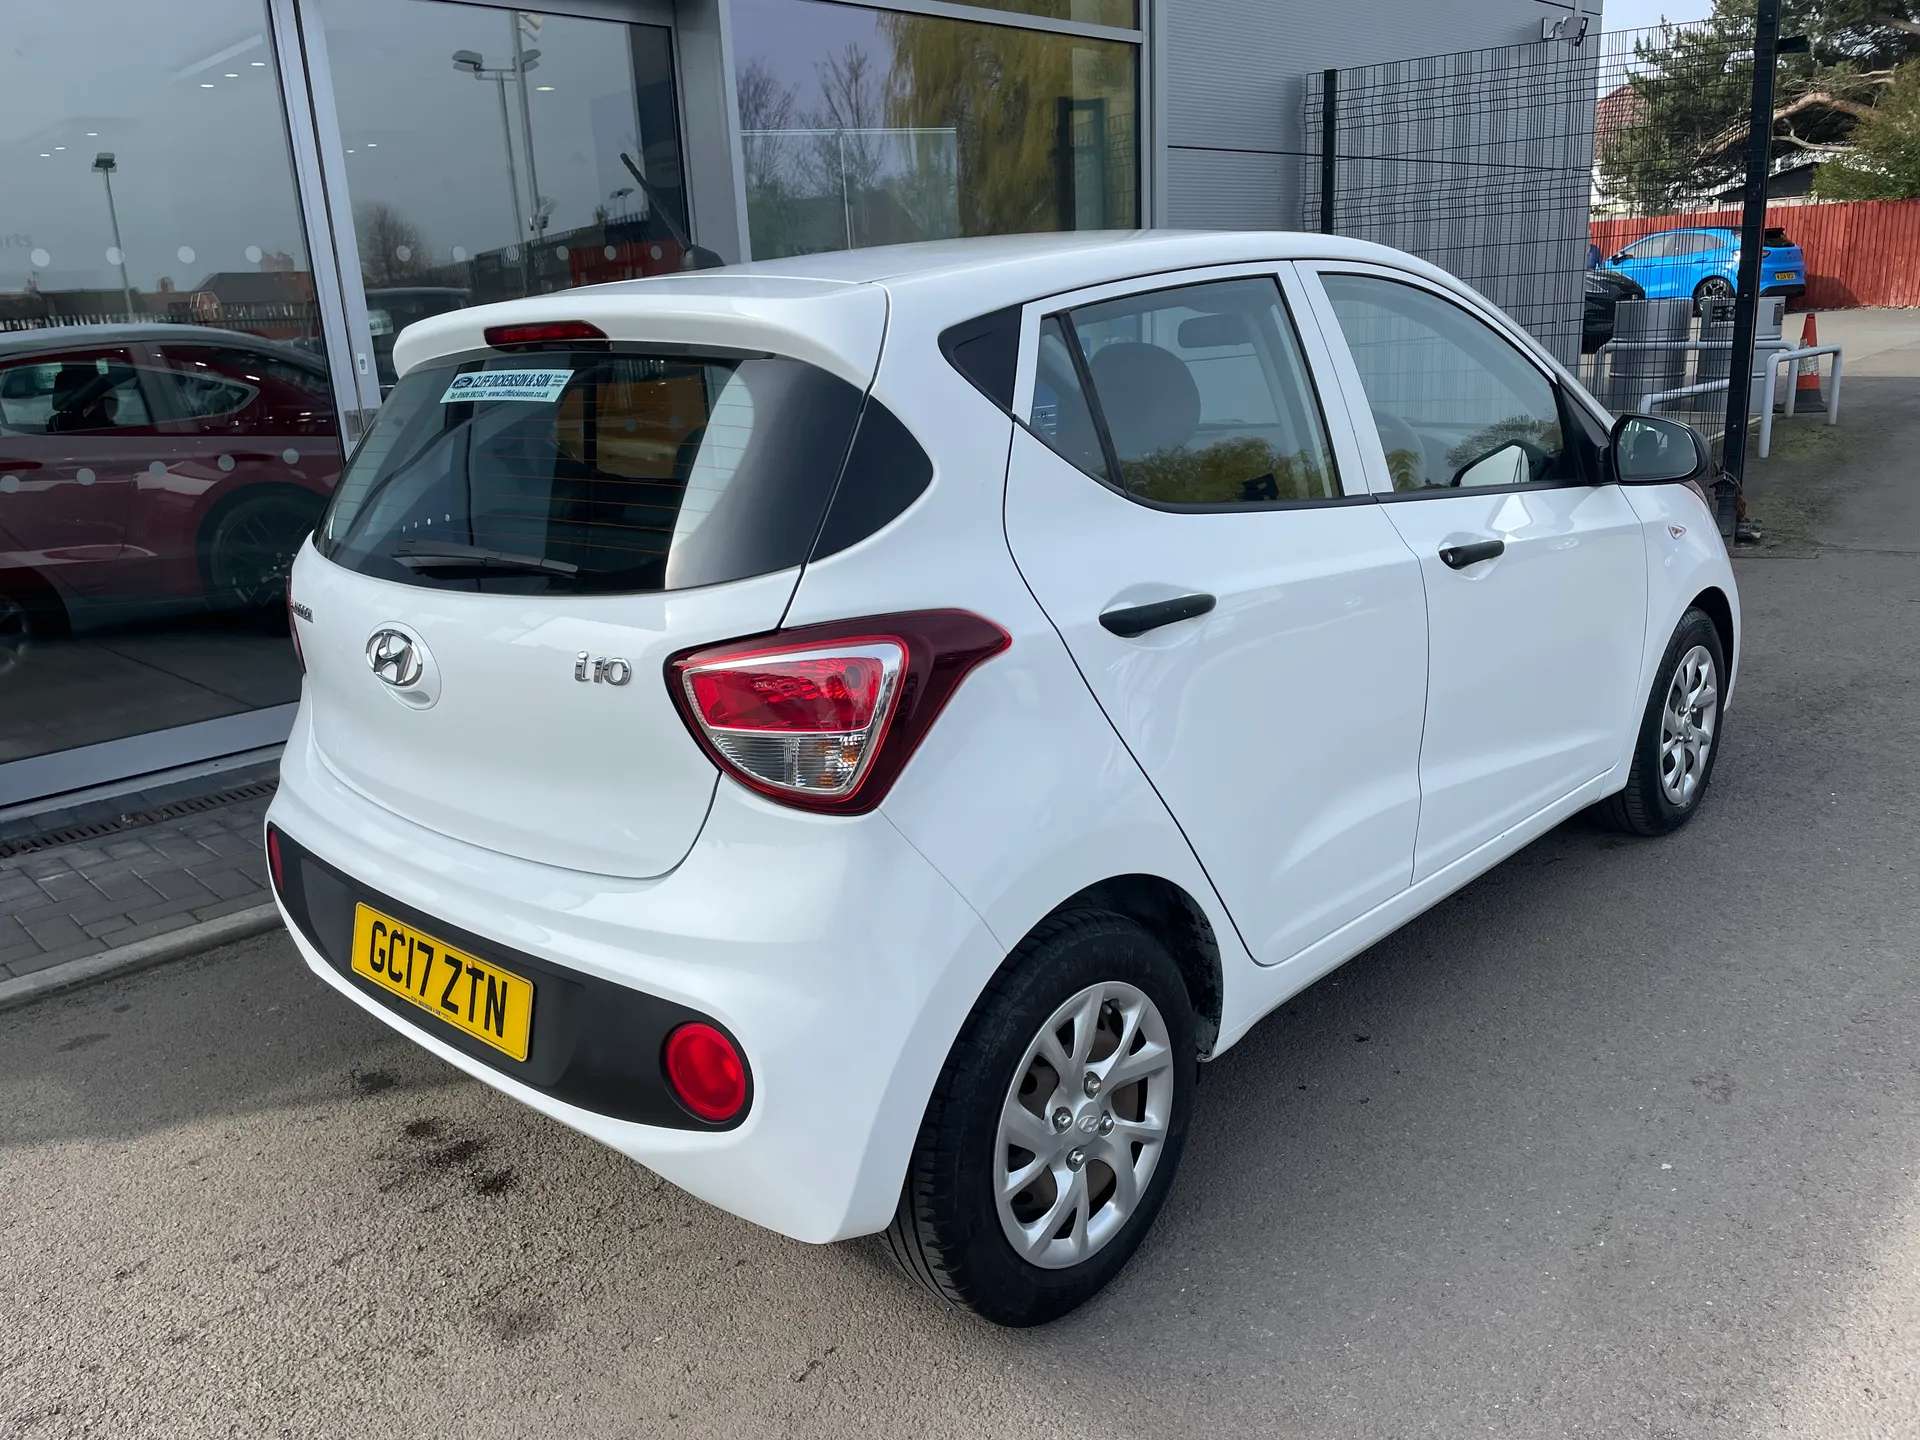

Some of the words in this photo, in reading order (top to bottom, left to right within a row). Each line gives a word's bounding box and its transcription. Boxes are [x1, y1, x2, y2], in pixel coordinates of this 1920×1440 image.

[472, 375, 495, 388] CLIFF
[490, 374, 530, 387] DICKENSON
[535, 374, 554, 387] SON
[573, 650, 633, 686] i10
[369, 920, 435, 997] GC17
[440, 953, 508, 1038] ZTN
